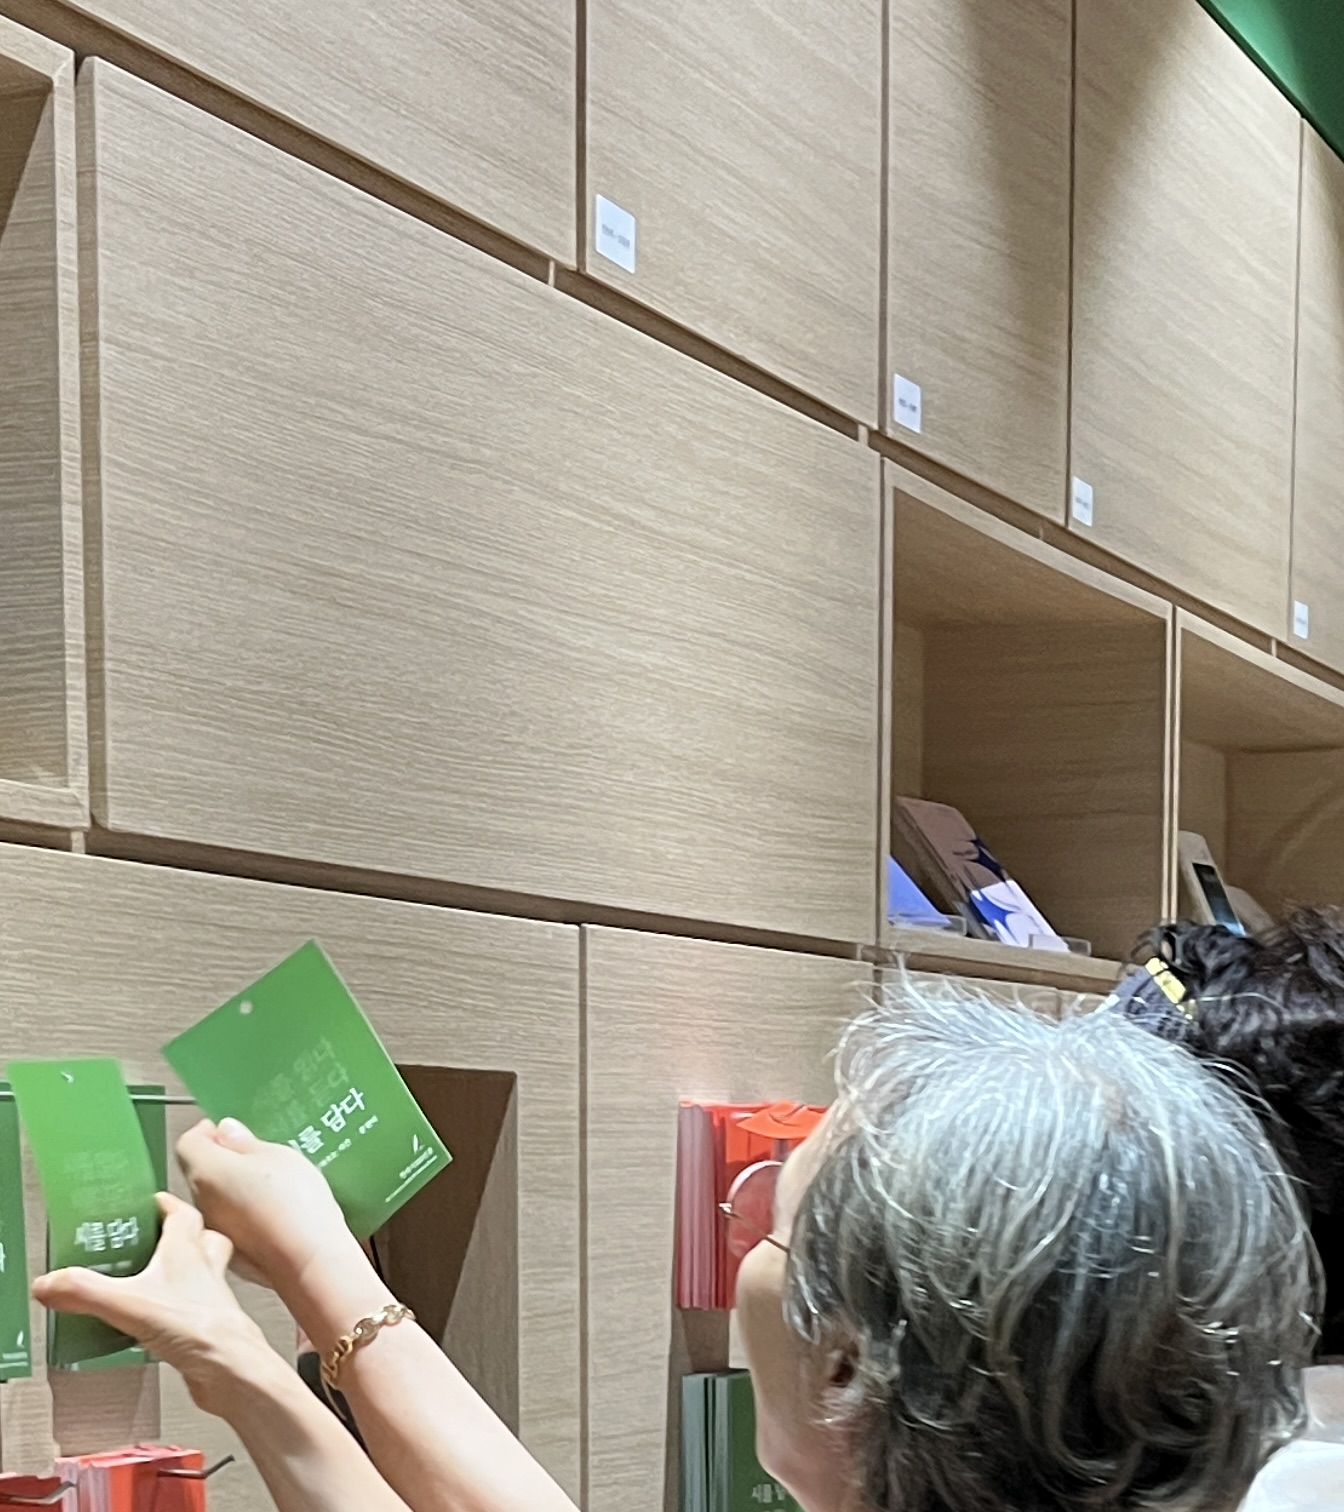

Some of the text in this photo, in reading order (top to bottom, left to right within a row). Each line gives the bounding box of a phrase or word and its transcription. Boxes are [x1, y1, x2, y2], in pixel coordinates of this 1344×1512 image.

[319, 1086, 366, 1133] 담다
[74, 1216, 141, 1253] 시를 담다
